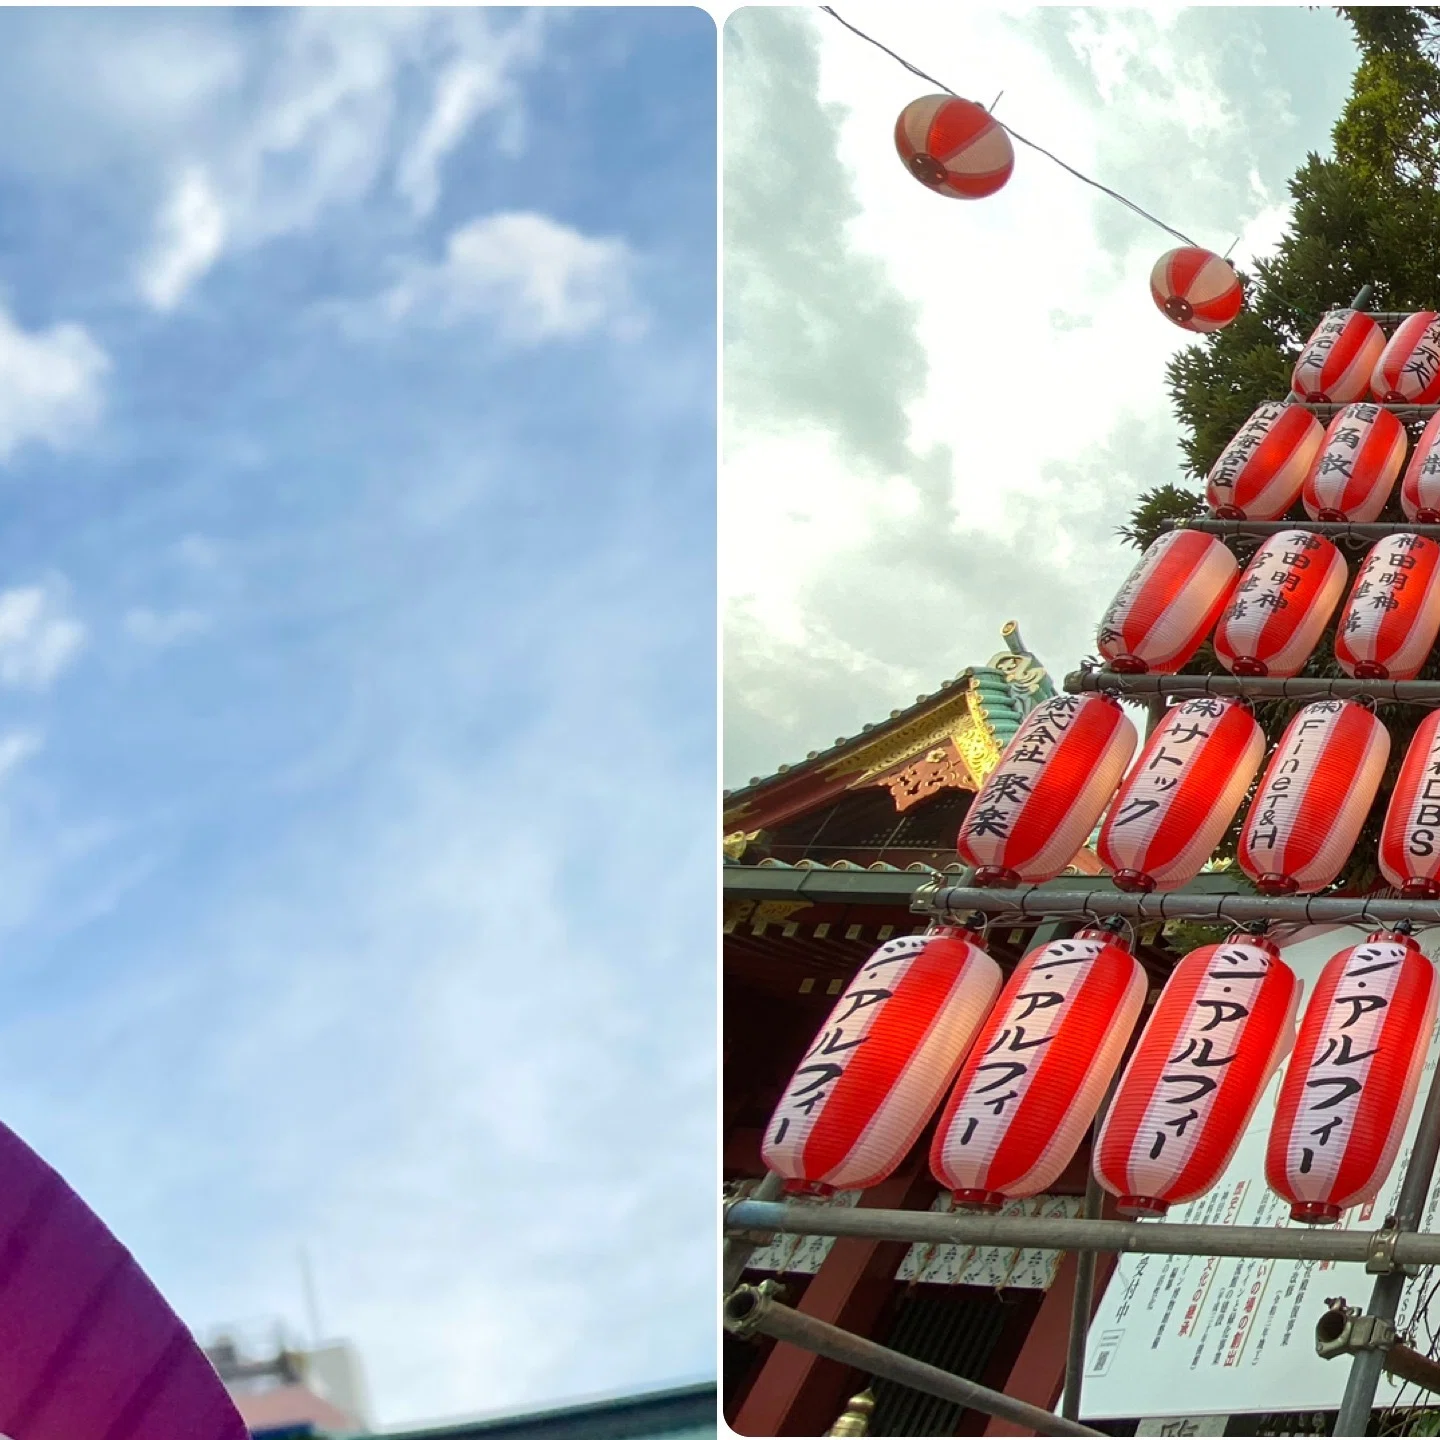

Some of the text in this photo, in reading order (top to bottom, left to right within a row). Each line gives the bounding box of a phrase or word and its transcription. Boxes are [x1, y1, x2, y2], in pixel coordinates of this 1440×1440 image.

[1367, 534, 1426, 612] 神田明神
[1299, 946, 1406, 1175] ジ・アルフィー
